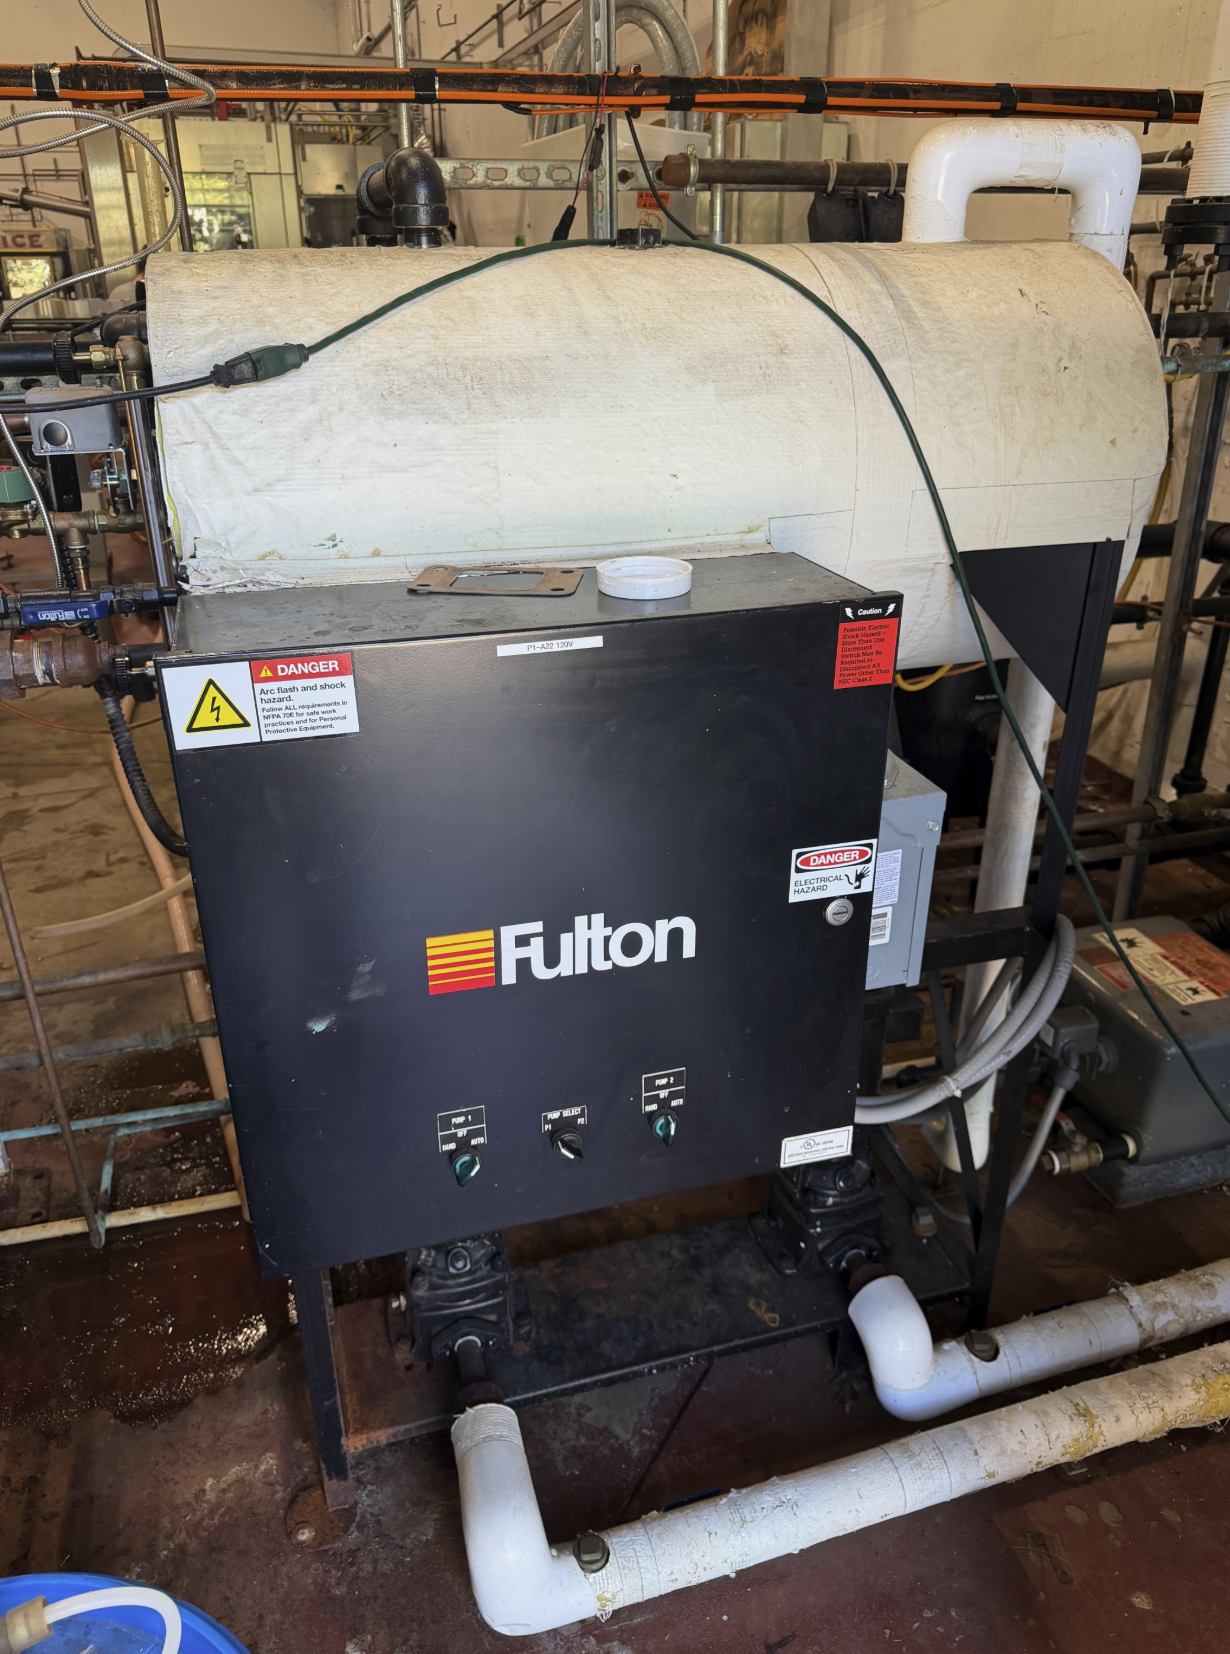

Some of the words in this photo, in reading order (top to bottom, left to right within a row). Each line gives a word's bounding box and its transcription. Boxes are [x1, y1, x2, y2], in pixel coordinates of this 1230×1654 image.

[2, 234, 43, 248] ICE
[37, 611, 65, 621] Fulton
[857, 607, 882, 616] Caution
[527, 643, 554, 652] P1-A22
[556, 641, 574, 649] 120V
[841, 645, 873, 653] Disconnect
[840, 658, 866, 666] Required
[277, 660, 339, 676] DANGER
[277, 686, 299, 694] flash
[301, 684, 317, 692] and
[319, 681, 346, 690] shock
[260, 695, 294, 704] hazard.
[262, 705, 283, 713] Follow
[298, 700, 340, 710] requirements
[264, 720, 295, 728] practices
[265, 727, 298, 735] Protective
[299, 723, 334, 732] Equipment.
[810, 850, 859, 866] DANGER
[794, 875, 844, 887] ELECTRICAL
[794, 885, 828, 895] HAZARD
[500, 913, 697, 986] Fulton
[655, 1078, 668, 1086] PUMP
[671, 1098, 684, 1107] AUTO
[645, 1103, 658, 1112] HAND
[547, 1112, 560, 1120] PUMP
[562, 1108, 581, 1117] SELECT
[451, 1116, 466, 1124] PUMP
[577, 1117, 585, 1125] P2
[457, 1130, 467, 1138] OFF
[471, 1137, 485, 1146] AUTO
[442, 1142, 456, 1151] HAND
